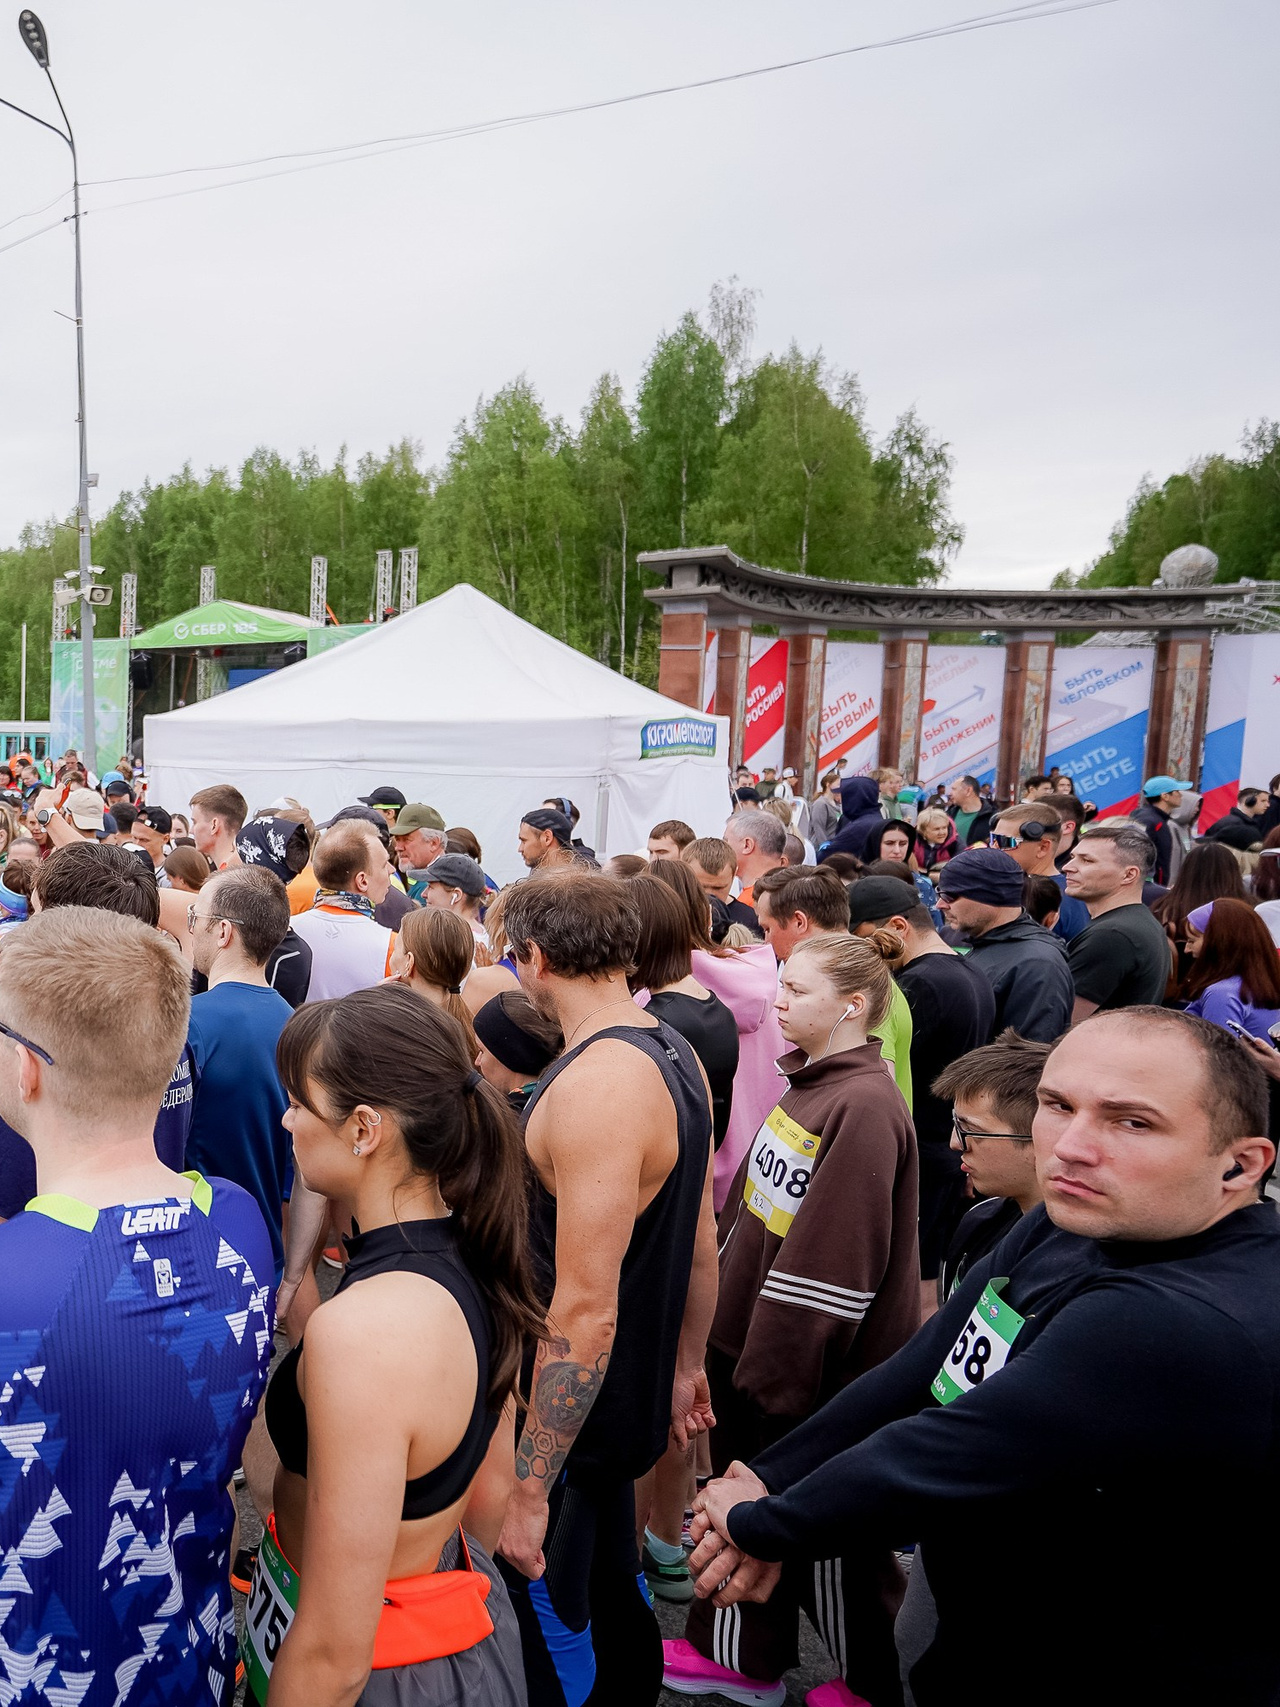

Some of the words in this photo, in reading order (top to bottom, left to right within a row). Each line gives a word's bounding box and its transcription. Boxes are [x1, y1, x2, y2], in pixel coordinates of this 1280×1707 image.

[191, 623, 226, 636] СБЕР
[75, 659, 117, 673] ртме
[1064, 667, 1104, 690] БЫТЬ
[746, 684, 767, 708] ЫТЬ
[1058, 660, 1144, 706] ЧЕЛОВЕКОМ
[745, 680, 785, 728] РОССИЕЙ
[923, 716, 961, 742] БЫТЬ
[931, 713, 996, 758] ДВИЖЕНИИ
[755, 1142, 811, 1199] 4008
